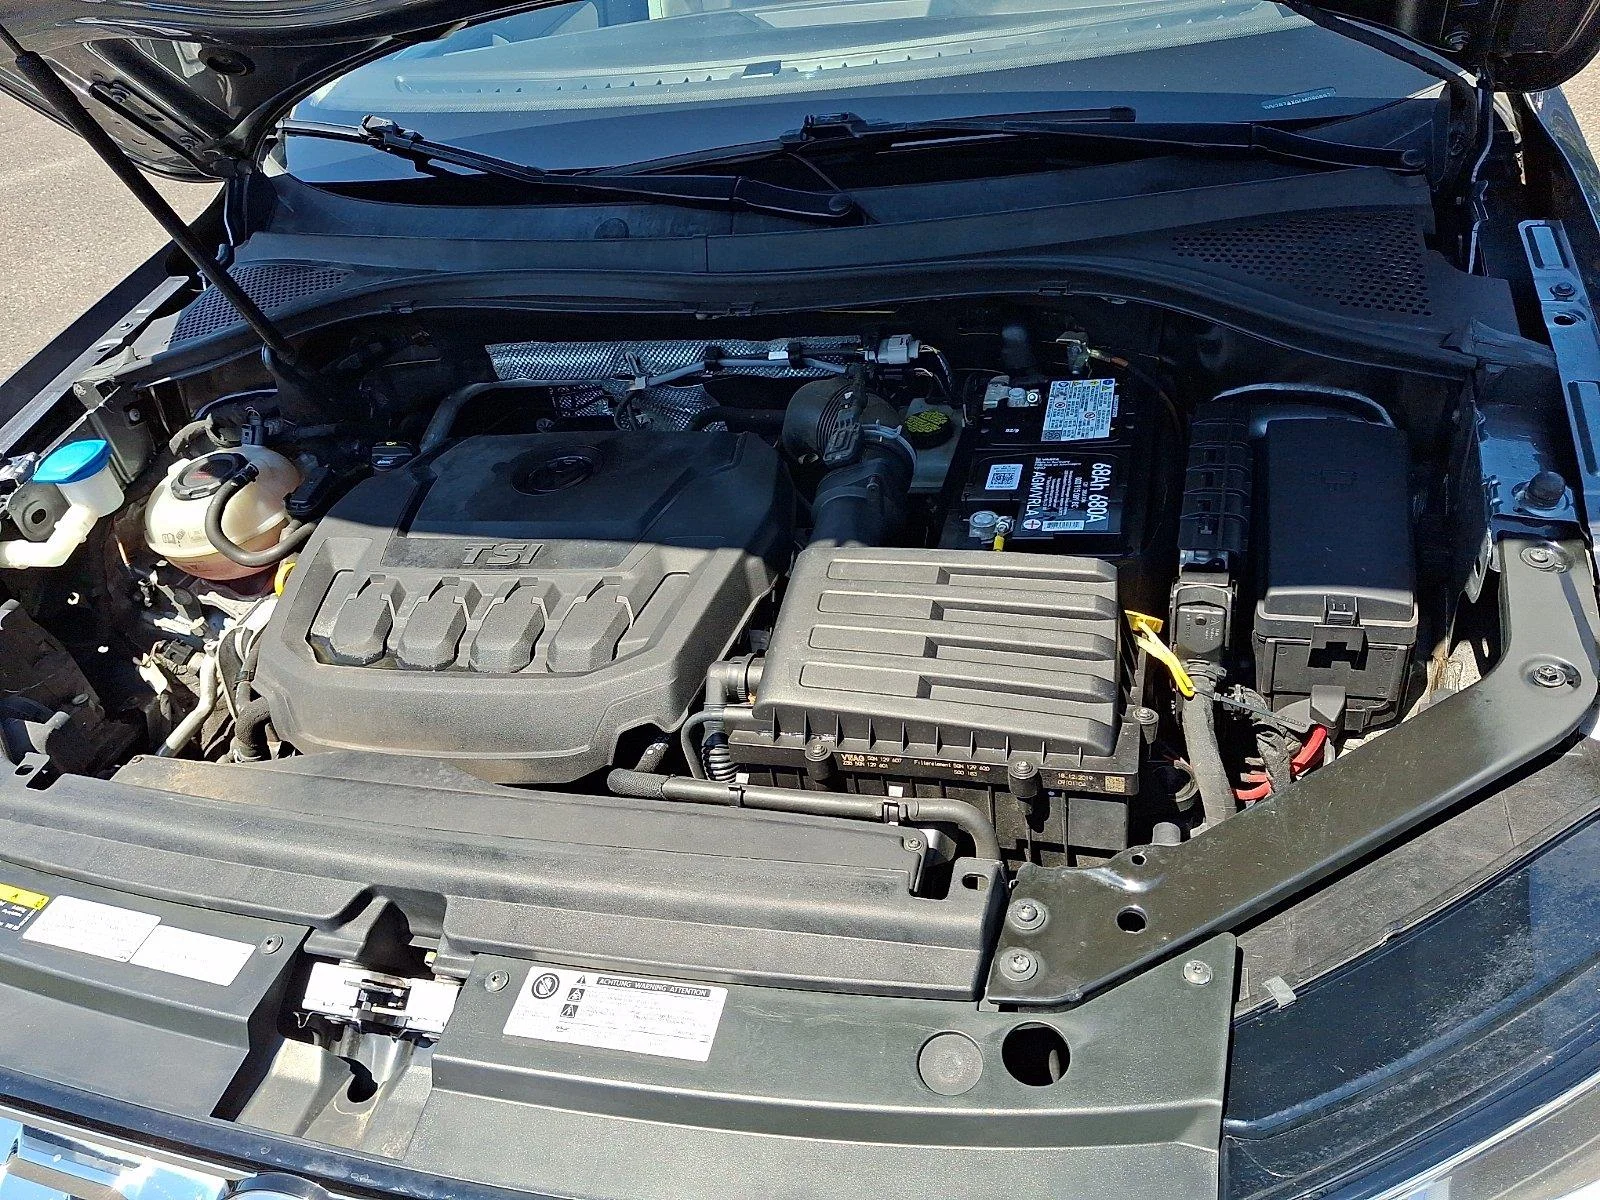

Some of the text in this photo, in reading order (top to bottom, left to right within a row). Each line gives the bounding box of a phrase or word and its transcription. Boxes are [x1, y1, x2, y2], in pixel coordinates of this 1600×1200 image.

[1025, 471, 1046, 517] AGM/VRLA
[1085, 463, 1112, 524] 68Ah 680A
[463, 543, 543, 566] TSI
[1057, 773, 1094, 781] 18.12.2019
[599, 978, 707, 997] ACHTUNG WARNING ATTENTION
